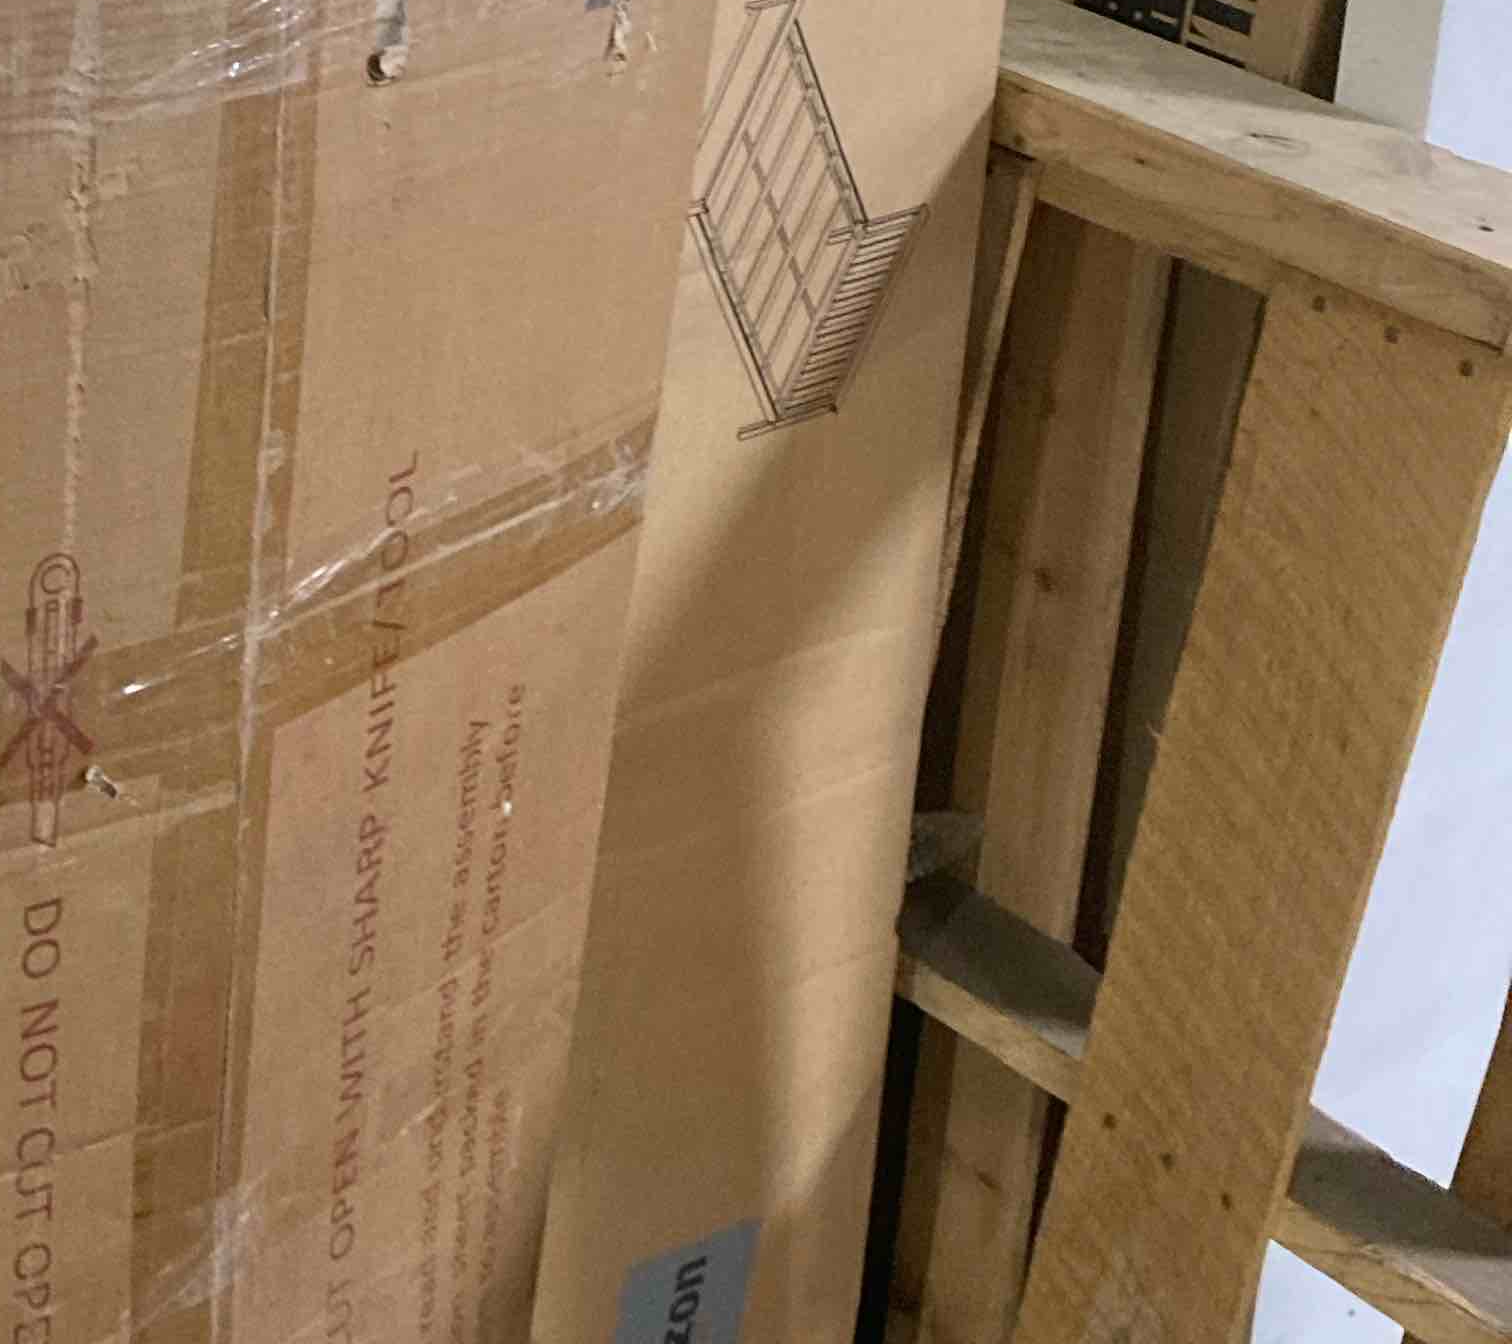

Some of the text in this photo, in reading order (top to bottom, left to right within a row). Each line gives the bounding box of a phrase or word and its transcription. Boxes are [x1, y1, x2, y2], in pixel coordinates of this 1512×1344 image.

[450, 719, 490, 888] assembly
[20, 897, 64, 981] DO
[347, 812, 389, 976] SHARP
[17, 997, 60, 1107] NOT
[335, 986, 373, 1124] WITH
[13, 1126, 57, 1224] CUT
[328, 1127, 364, 1262] OPEN
